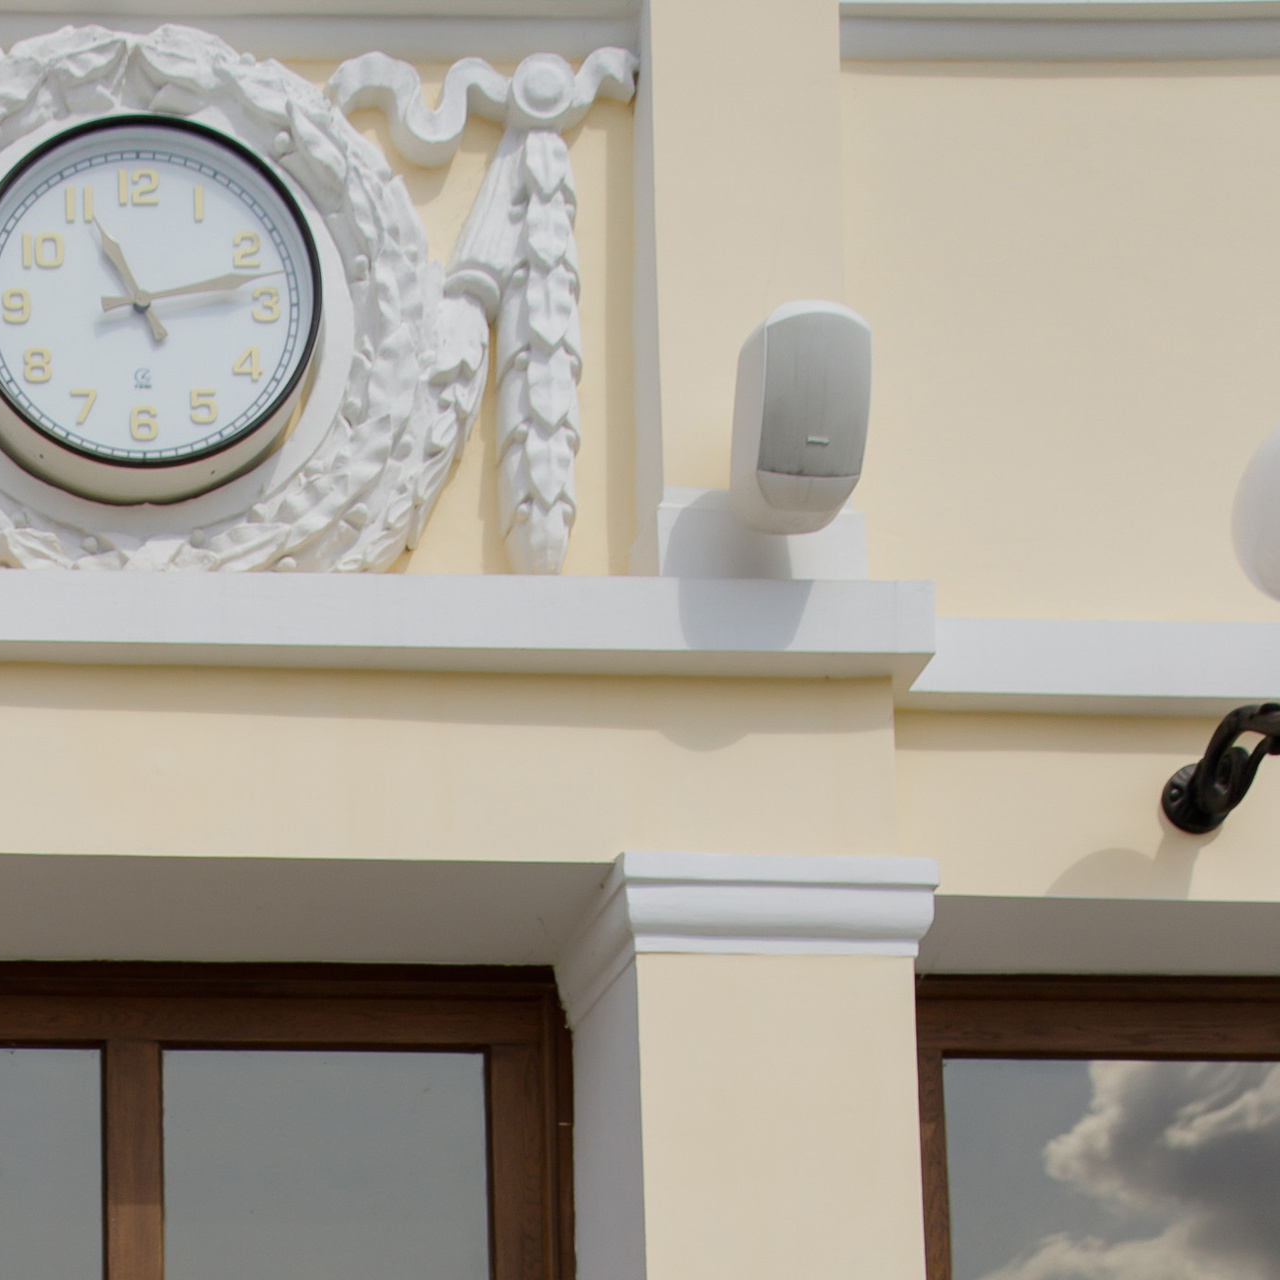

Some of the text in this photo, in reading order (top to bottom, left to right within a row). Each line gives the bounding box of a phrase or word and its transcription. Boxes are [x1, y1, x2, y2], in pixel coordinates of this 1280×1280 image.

[65, 186, 93, 222] 11
[118, 168, 159, 206] 12
[194, 185, 204, 222] 1
[21, 232, 64, 269] 10
[232, 231, 261, 268] 2
[2, 287, 31, 324] 9
[252, 286, 280, 323] 3
[23, 347, 52, 383] 8
[232, 346, 262, 382] 4
[69, 388, 97, 425] 7
[130, 405, 158, 441] 6
[189, 387, 218, 424] 5
